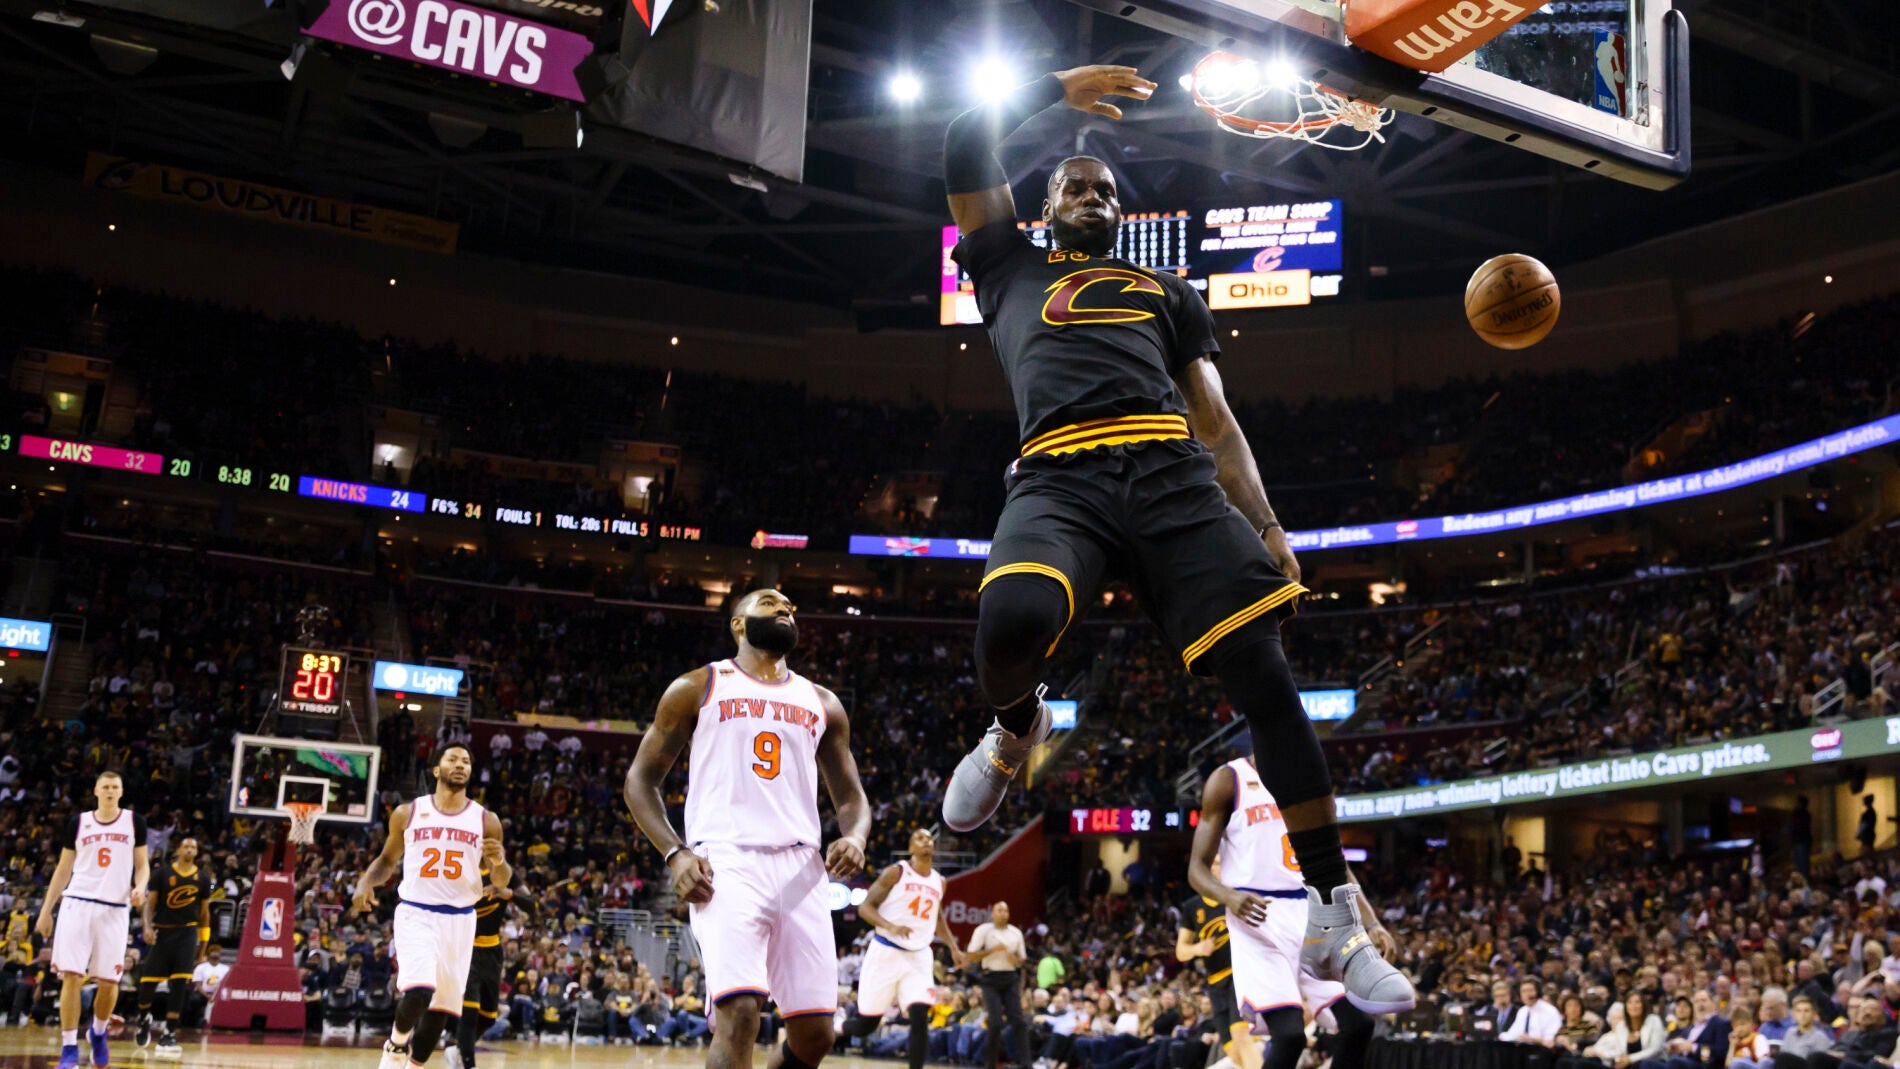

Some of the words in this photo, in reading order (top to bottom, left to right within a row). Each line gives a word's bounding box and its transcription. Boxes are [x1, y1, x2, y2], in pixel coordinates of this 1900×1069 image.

[1394, 0, 1526, 61] Farm
[1598, 94, 1617, 110] NBA
[160, 168, 373, 233] LOUDVILLE
[1229, 282, 1288, 299] Ohio
[50, 440, 93, 463] CAVS
[124, 452, 145, 470] 32
[170, 458, 191, 477] 20
[218, 465, 251, 486] 8:38
[269, 473, 290, 492] 2Q
[311, 478, 367, 502] KNICKS
[390, 490, 409, 509] 24
[431, 498, 459, 515] FG%
[464, 502, 482, 519] 34
[495, 507, 532, 525] FOULS
[535, 511, 542, 527] 1
[603, 518, 609, 533] 1
[611, 519, 639, 536] FULL
[640, 521, 649, 537] 5
[957, 539, 992, 555] Tur
[0, 623, 41, 647] ight
[302, 653, 341, 673] 8:37
[292, 669, 334, 701] 20
[411, 670, 454, 694] Light
[299, 702, 339, 715] TISSOT
[719, 698, 768, 723] NEW
[768, 700, 819, 738] YORK
[752, 731, 781, 780] 9
[1335, 797, 1376, 818] Turn
[1375, 795, 1404, 816] any
[1405, 779, 1501, 810] non-winning
[1502, 772, 1559, 797] lottery
[1558, 763, 1609, 790] ticket
[1611, 757, 1650, 783] into
[1652, 751, 1699, 777] Cavs
[1701, 742, 1771, 777] prizes.
[1091, 809, 1121, 832] CLE
[1130, 809, 1151, 831] 32
[81, 833, 103, 847] NEW
[104, 832, 130, 845] YORK
[413, 826, 445, 843] NEW
[445, 827, 480, 849] YORK
[97, 847, 112, 868] 6
[420, 847, 465, 880] 25
[908, 895, 935, 921] 42
[231, 989, 248, 1000] NBA
[249, 990, 280, 1001] LEAGUE
[281, 991, 303, 1002] PASS
